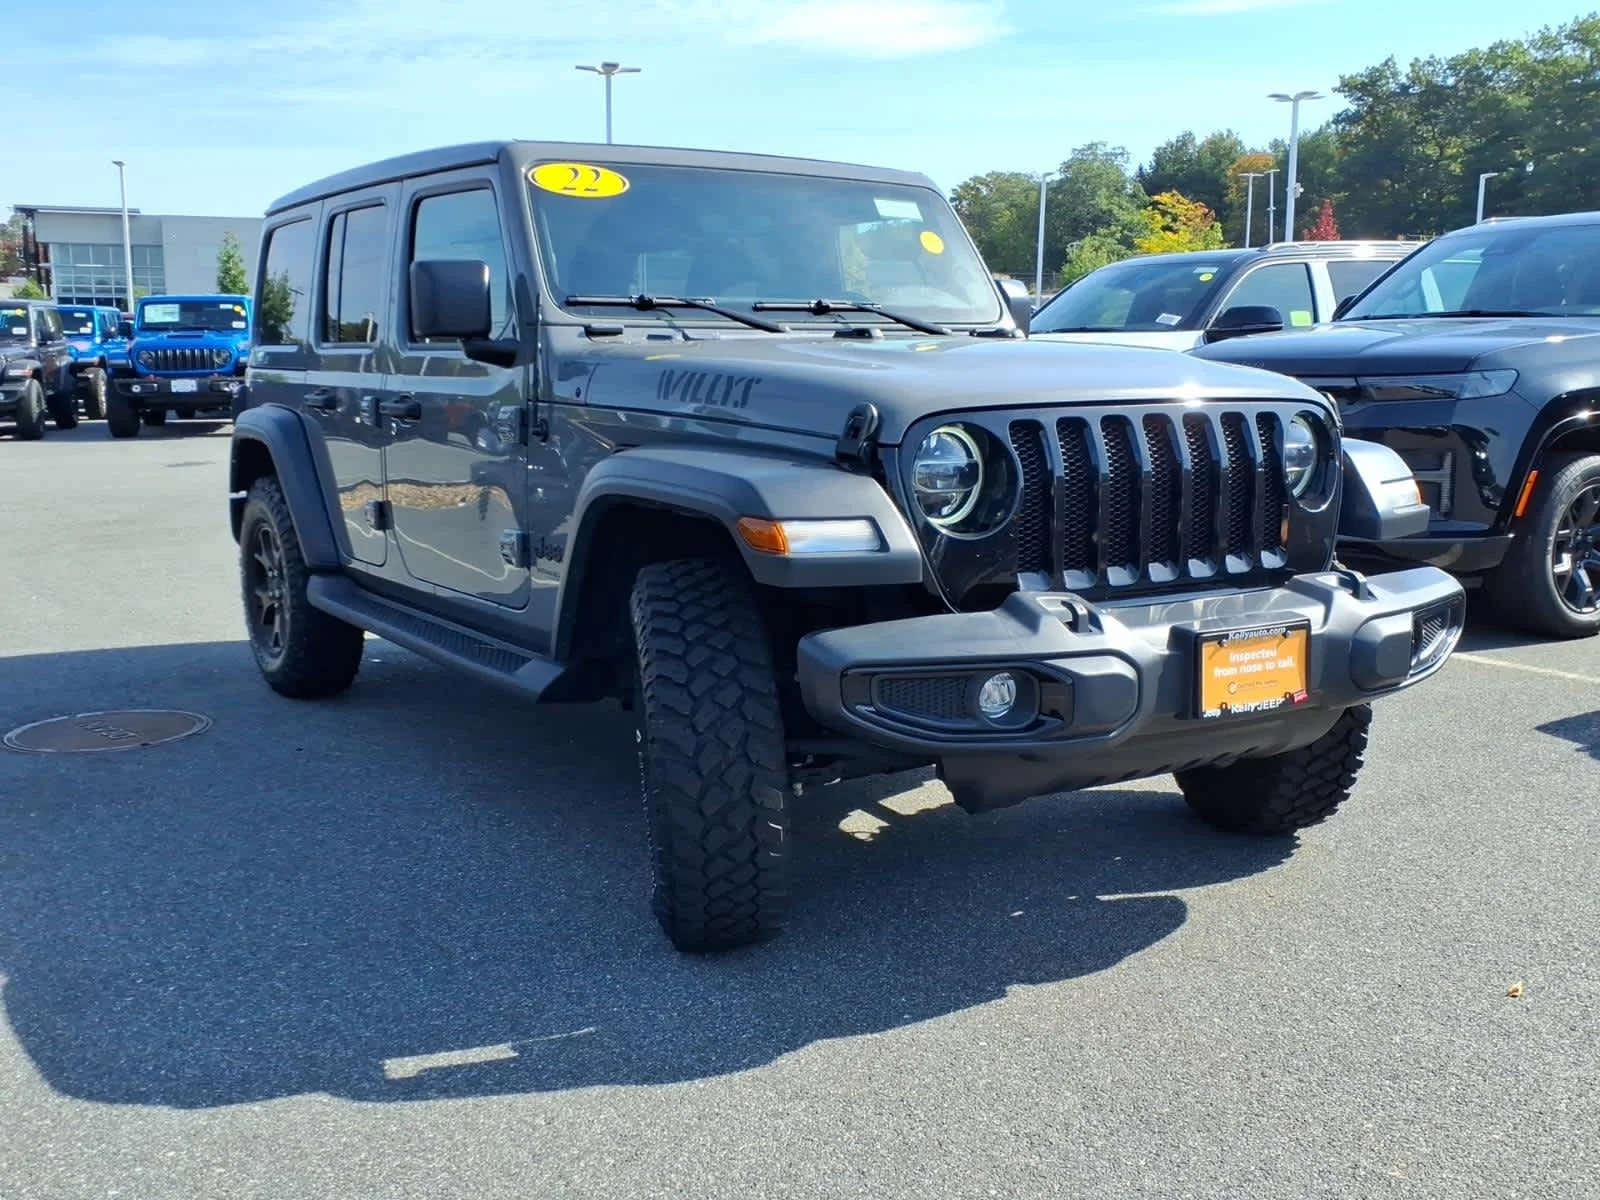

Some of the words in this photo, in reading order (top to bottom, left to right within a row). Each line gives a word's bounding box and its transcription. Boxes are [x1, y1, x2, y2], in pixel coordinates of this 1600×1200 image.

[560, 167, 601, 192] 22
[656, 369, 762, 409] WILLYS
[1230, 649, 1277, 662] Inspected
[1214, 666, 1238, 677] from
[1240, 663, 1263, 674] nose
[1264, 661, 1276, 671] to
[1257, 697, 1286, 711] JEEP
